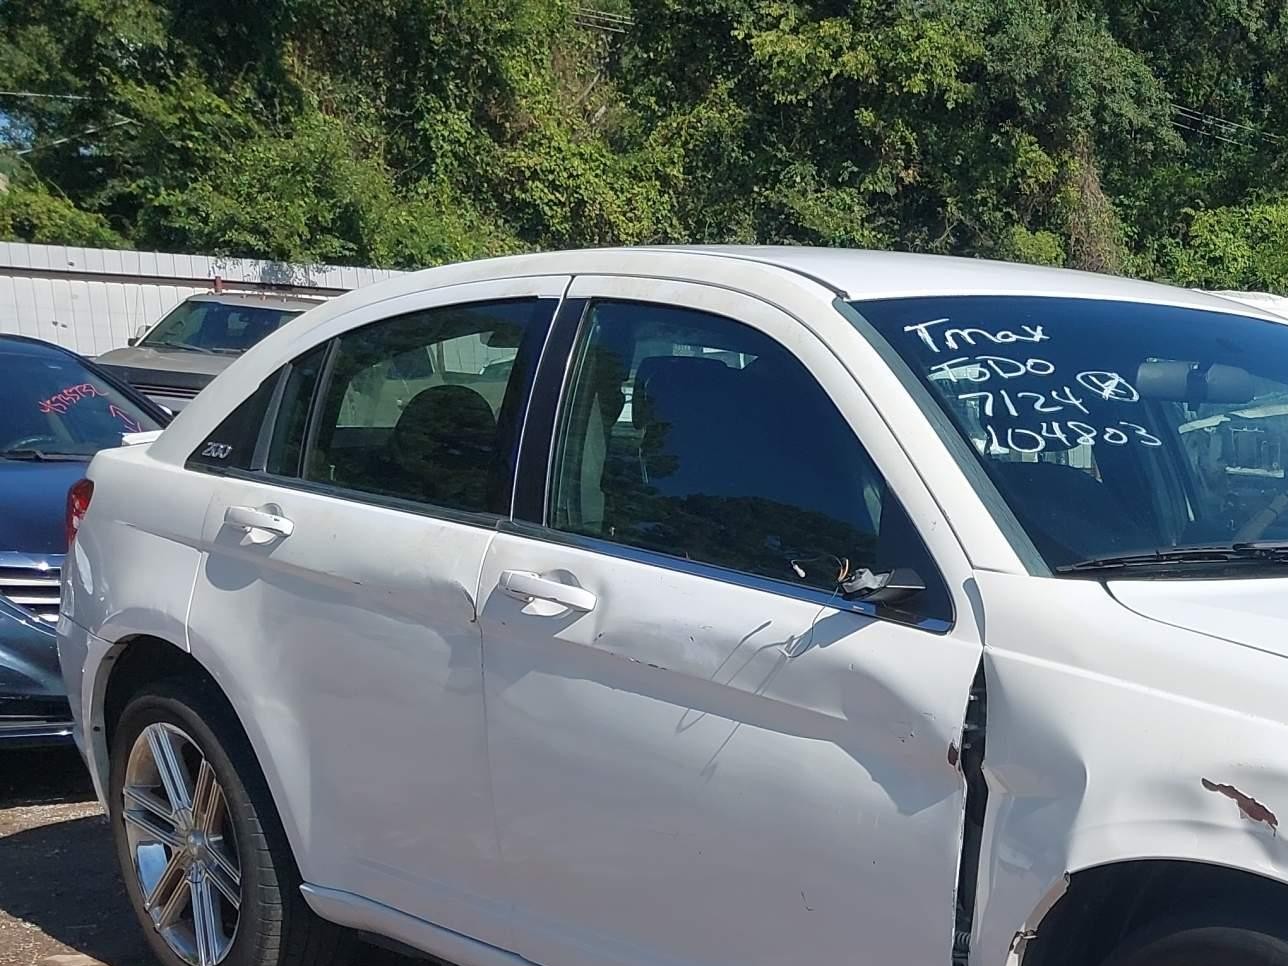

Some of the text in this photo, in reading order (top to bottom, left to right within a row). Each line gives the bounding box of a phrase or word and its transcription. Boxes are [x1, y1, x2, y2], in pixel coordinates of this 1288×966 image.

[958, 386, 1090, 417] 7124
[202, 442, 233, 458] 200
[986, 421, 1162, 454] 104803
